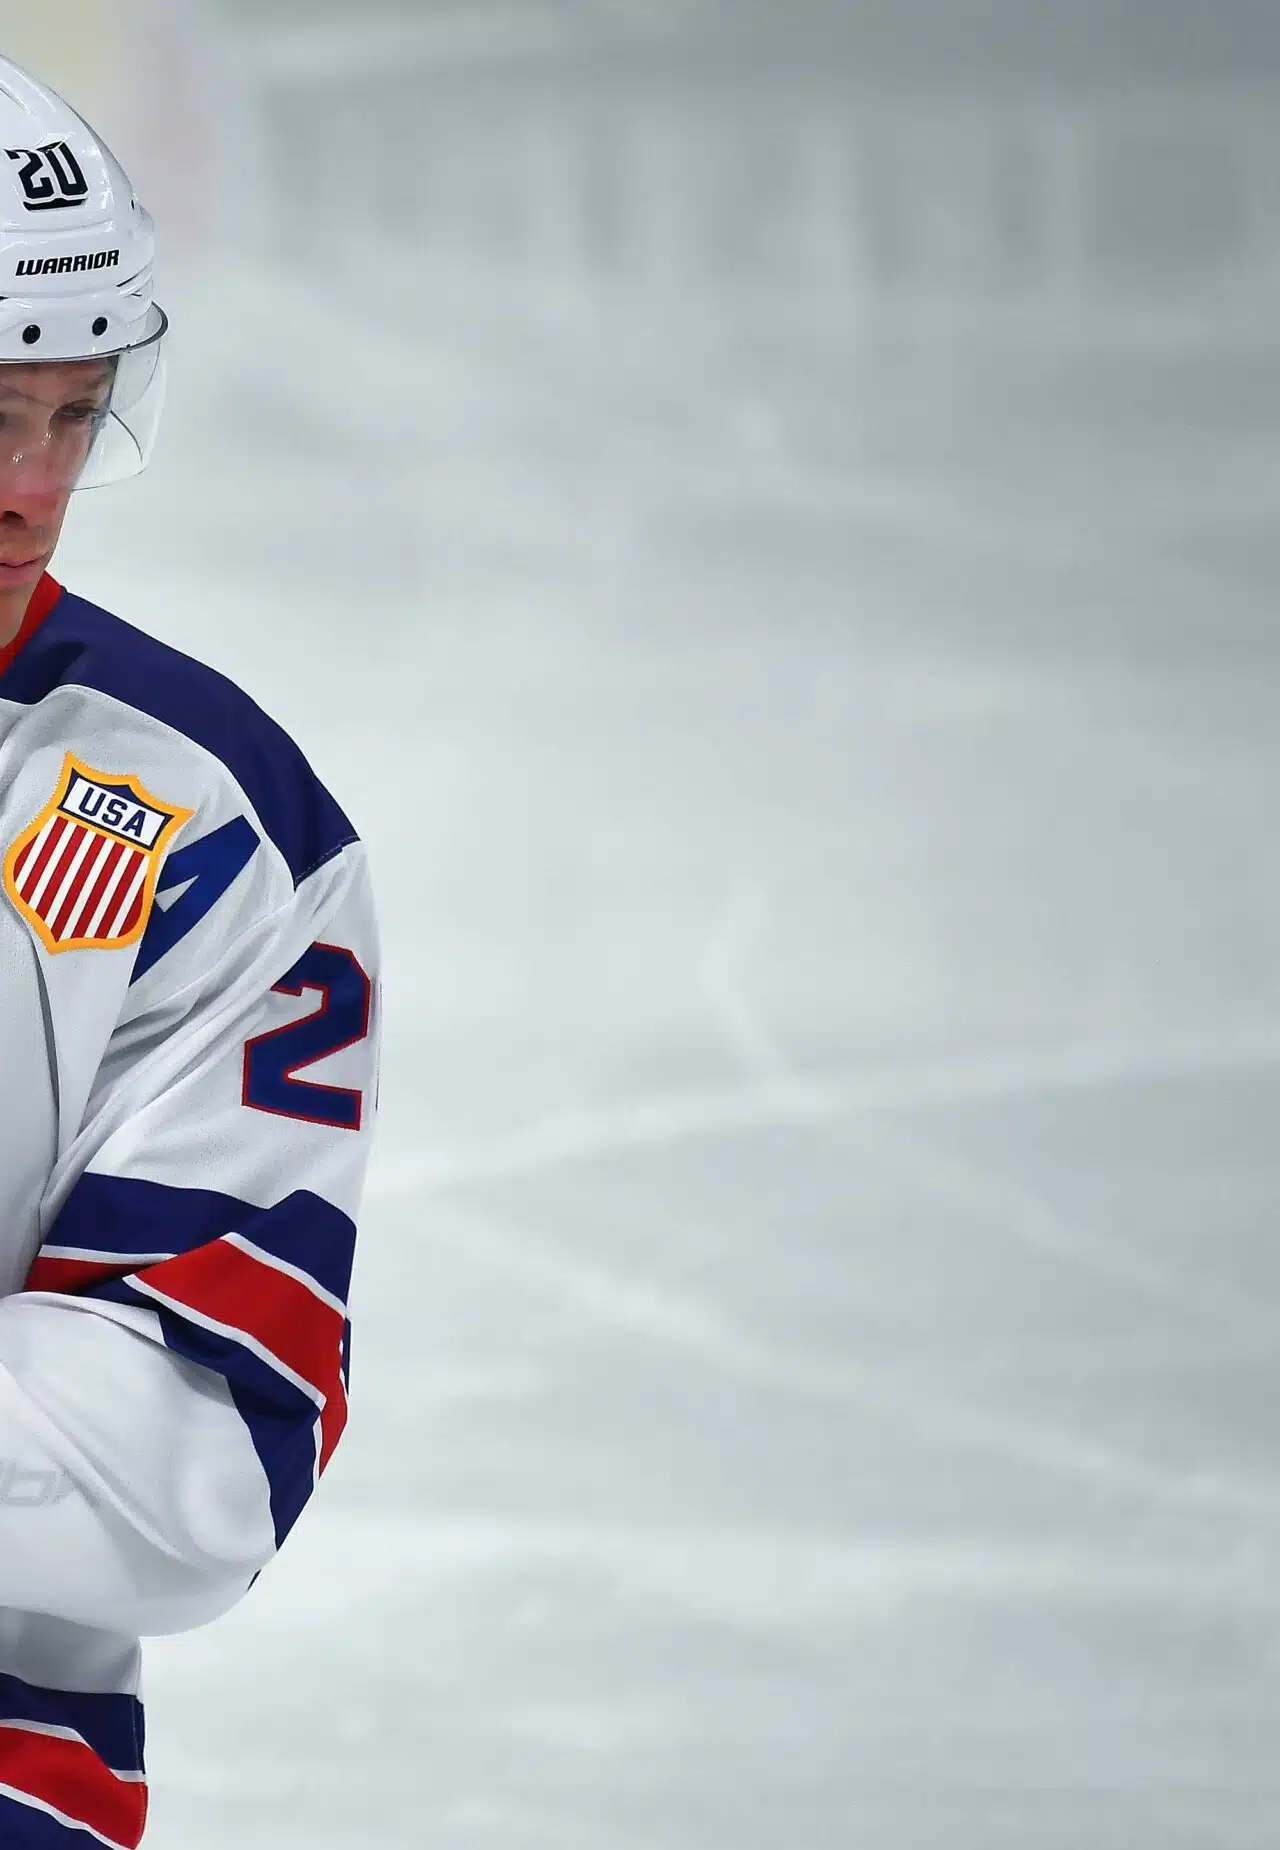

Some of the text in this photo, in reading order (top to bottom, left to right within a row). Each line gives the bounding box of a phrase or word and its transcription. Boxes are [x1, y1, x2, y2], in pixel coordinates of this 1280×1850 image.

[3, 141, 89, 200] 20
[15, 249, 120, 277] WARRIOR
[78, 786, 148, 838] USA
[241, 940, 382, 1132] 2
